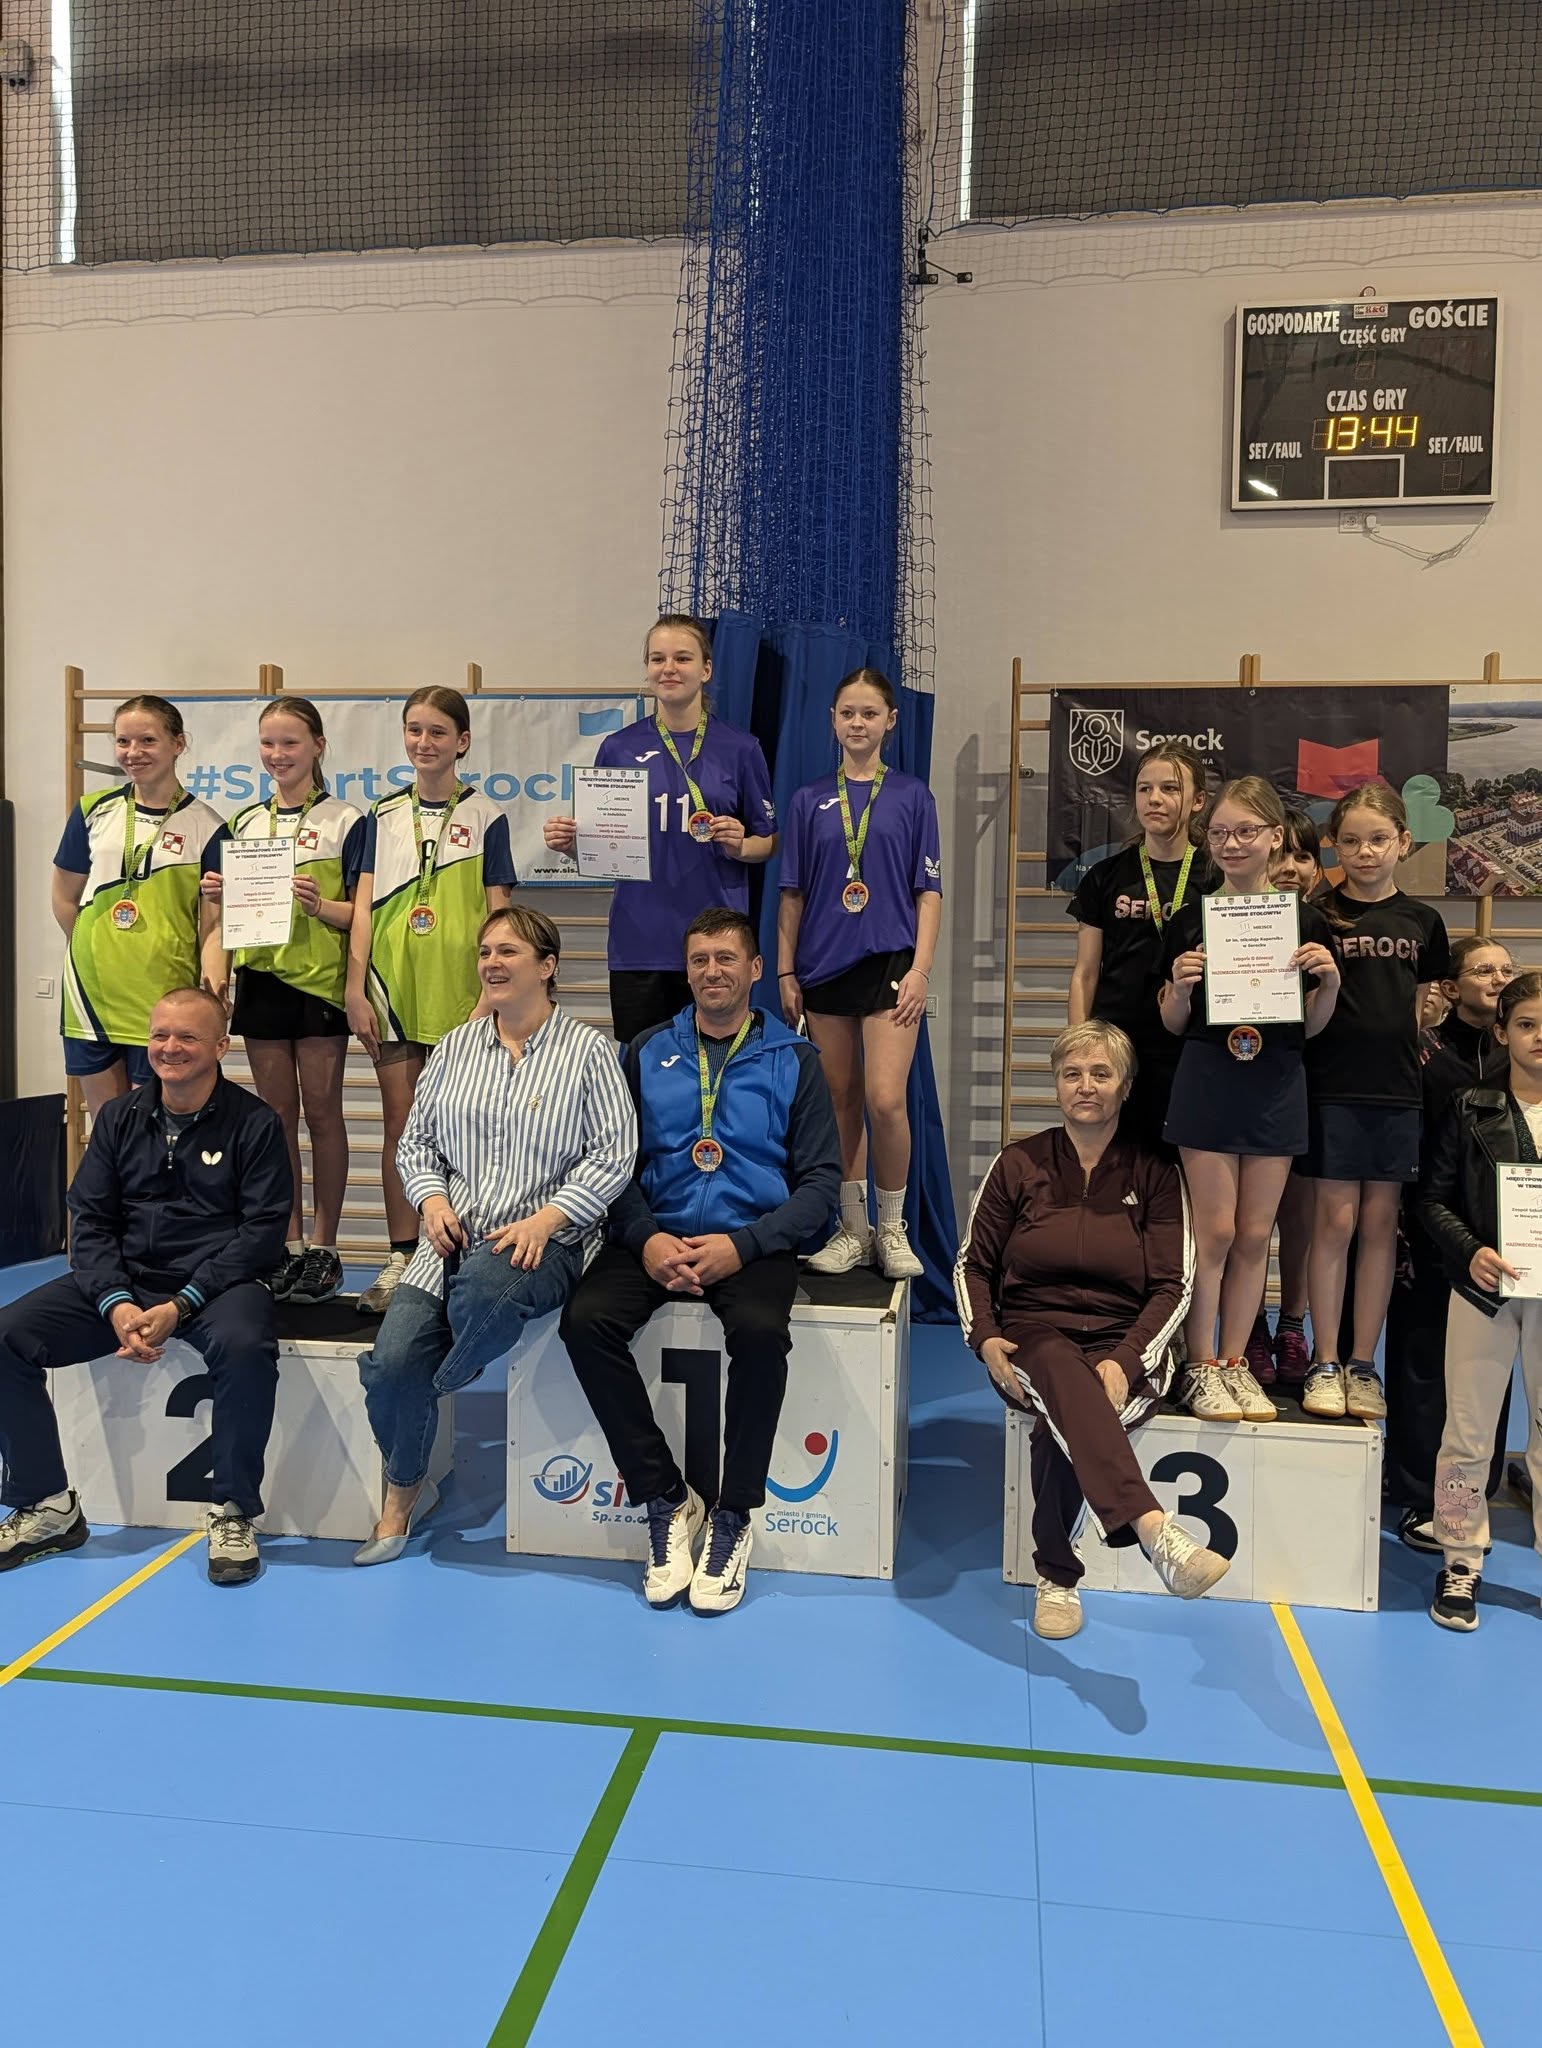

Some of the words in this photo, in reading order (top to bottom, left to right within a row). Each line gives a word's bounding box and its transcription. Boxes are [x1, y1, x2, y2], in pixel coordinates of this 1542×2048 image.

[1247, 311, 1340, 335] GOSPODARZE
[1409, 301, 1488, 329] GOŚCIE
[1339, 325, 1377, 348] CZĘŚĆ
[1381, 327, 1407, 344] GRY
[1326, 390, 1367, 412] CZAS
[1373, 388, 1407, 411] GRY
[1327, 416, 1418, 451] 13:44
[1428, 436, 1484, 455] SET/FAUL
[1248, 441, 1302, 460] SET/FAUL
[655, 793, 690, 833] 11
[661, 1347, 721, 1521] 1
[592, 1511, 612, 1525] Sp.
[776, 1510, 800, 1518] miasto
[805, 1512, 827, 1521] gmina
[1141, 1451, 1239, 1563] 3
[765, 1512, 839, 1537] Serock
